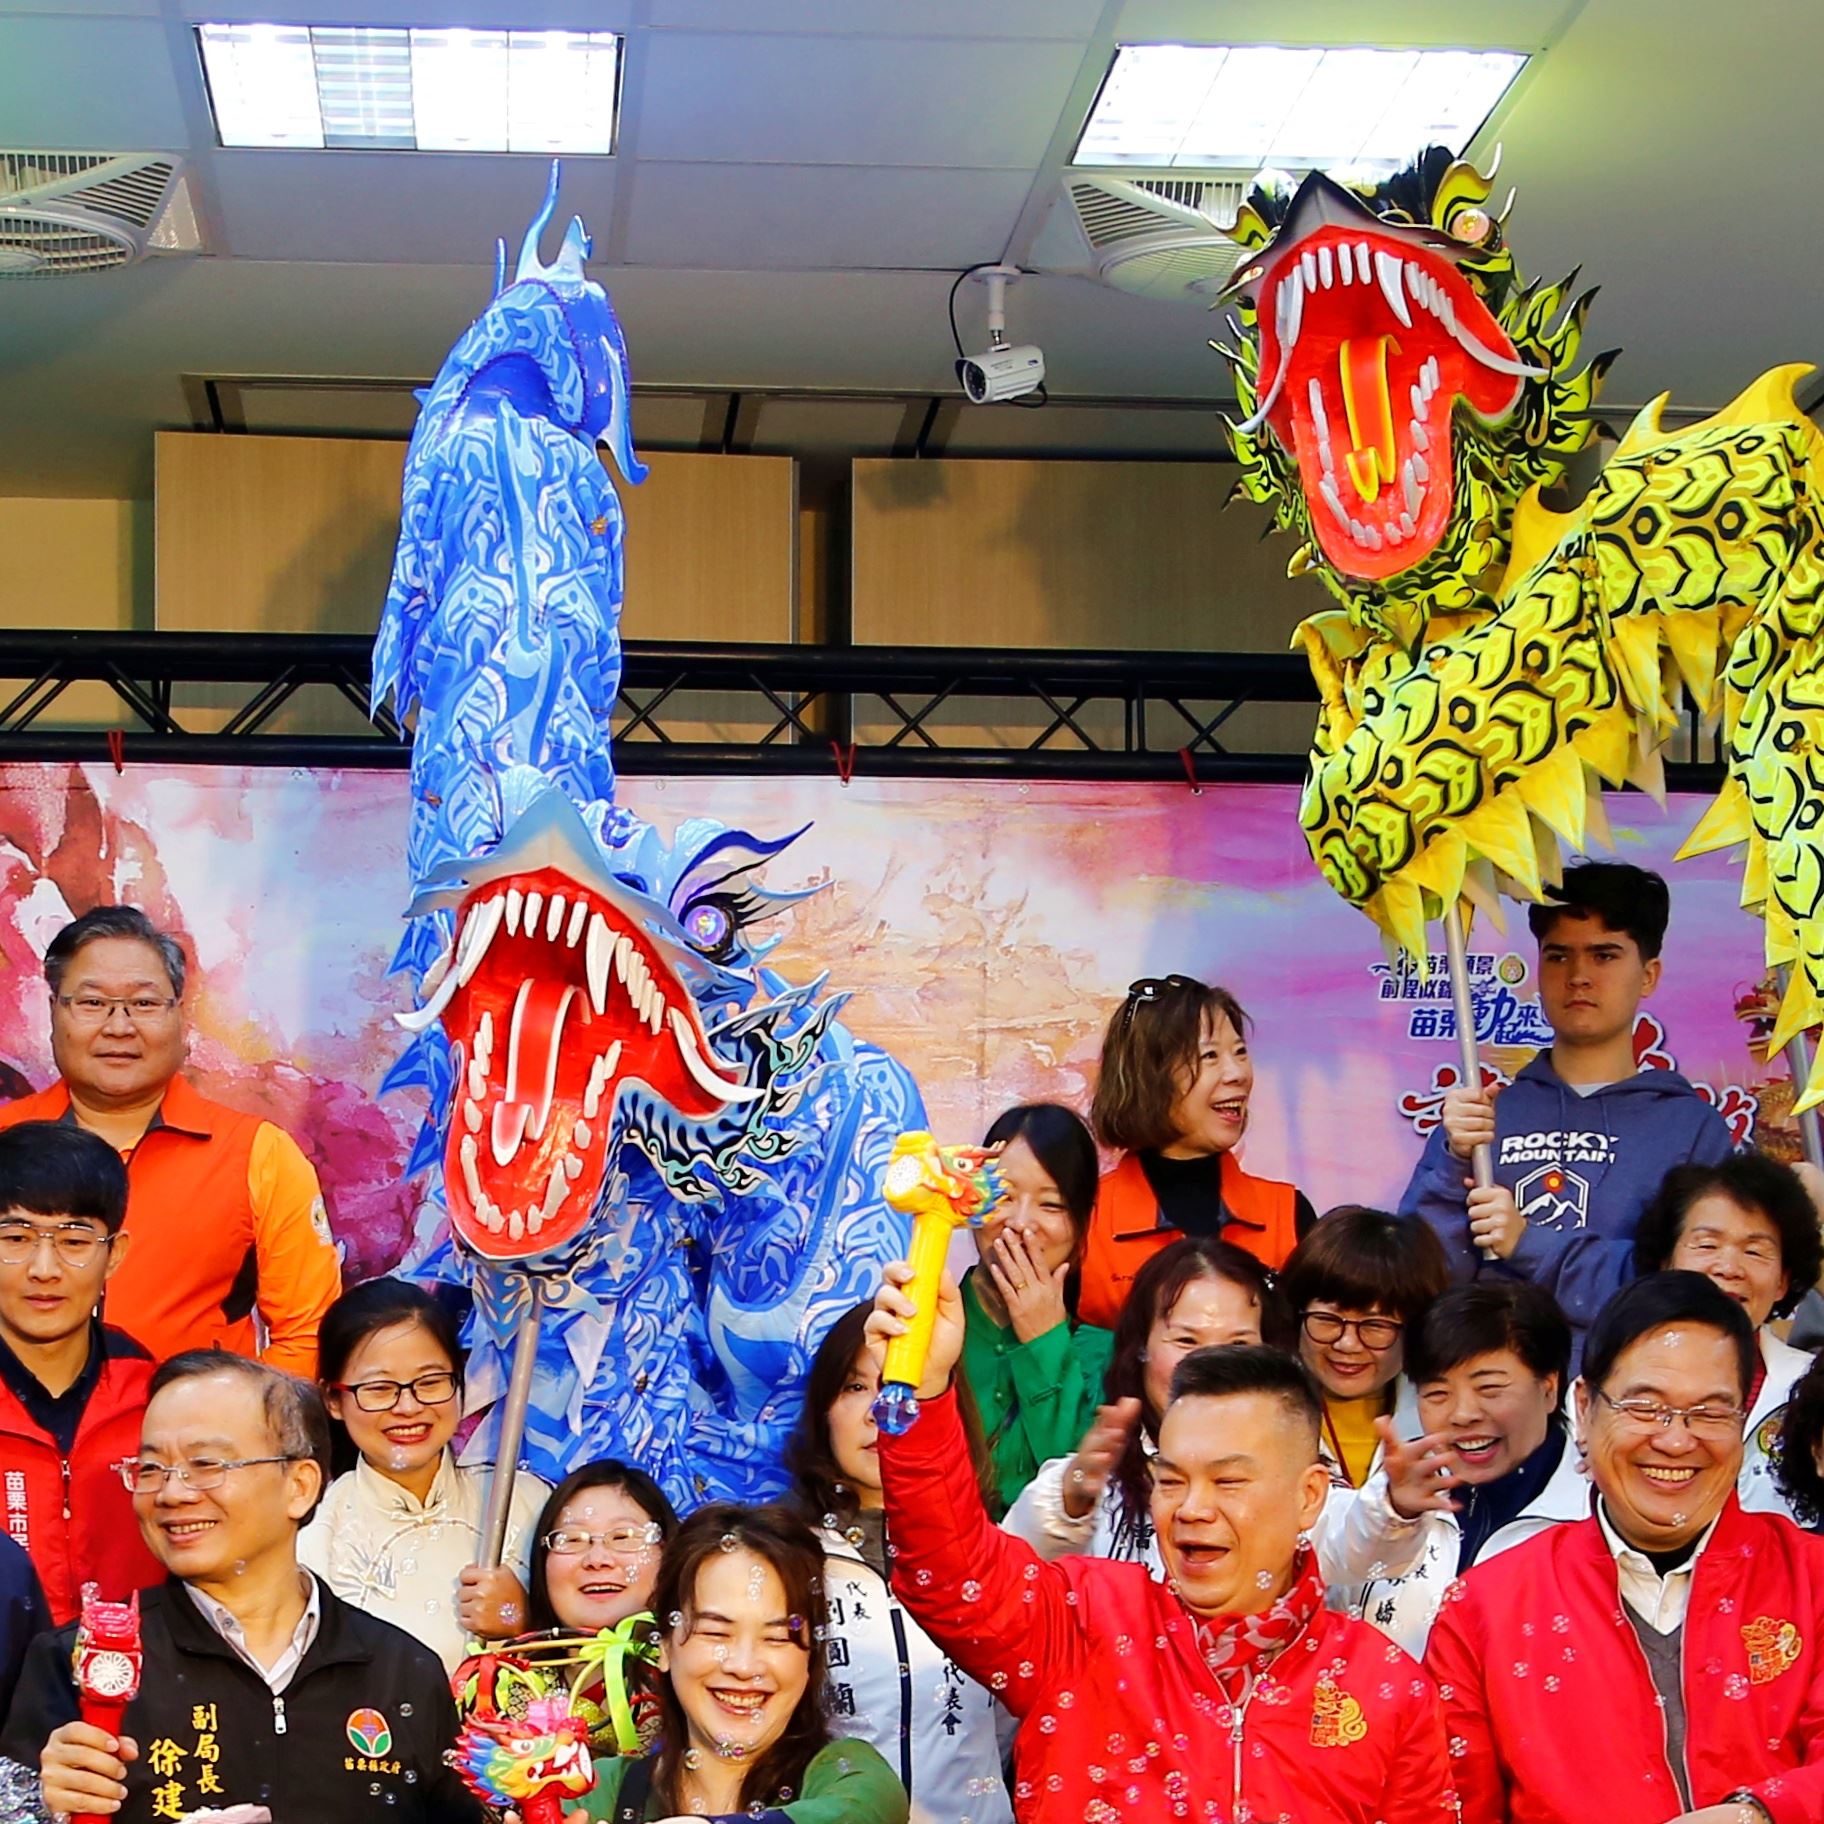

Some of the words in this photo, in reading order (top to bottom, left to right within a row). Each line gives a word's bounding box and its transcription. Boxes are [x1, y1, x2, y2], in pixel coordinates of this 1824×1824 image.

[1500, 1131, 1619, 1151] ROCKY
[192, 1703, 224, 1795] 副局長
